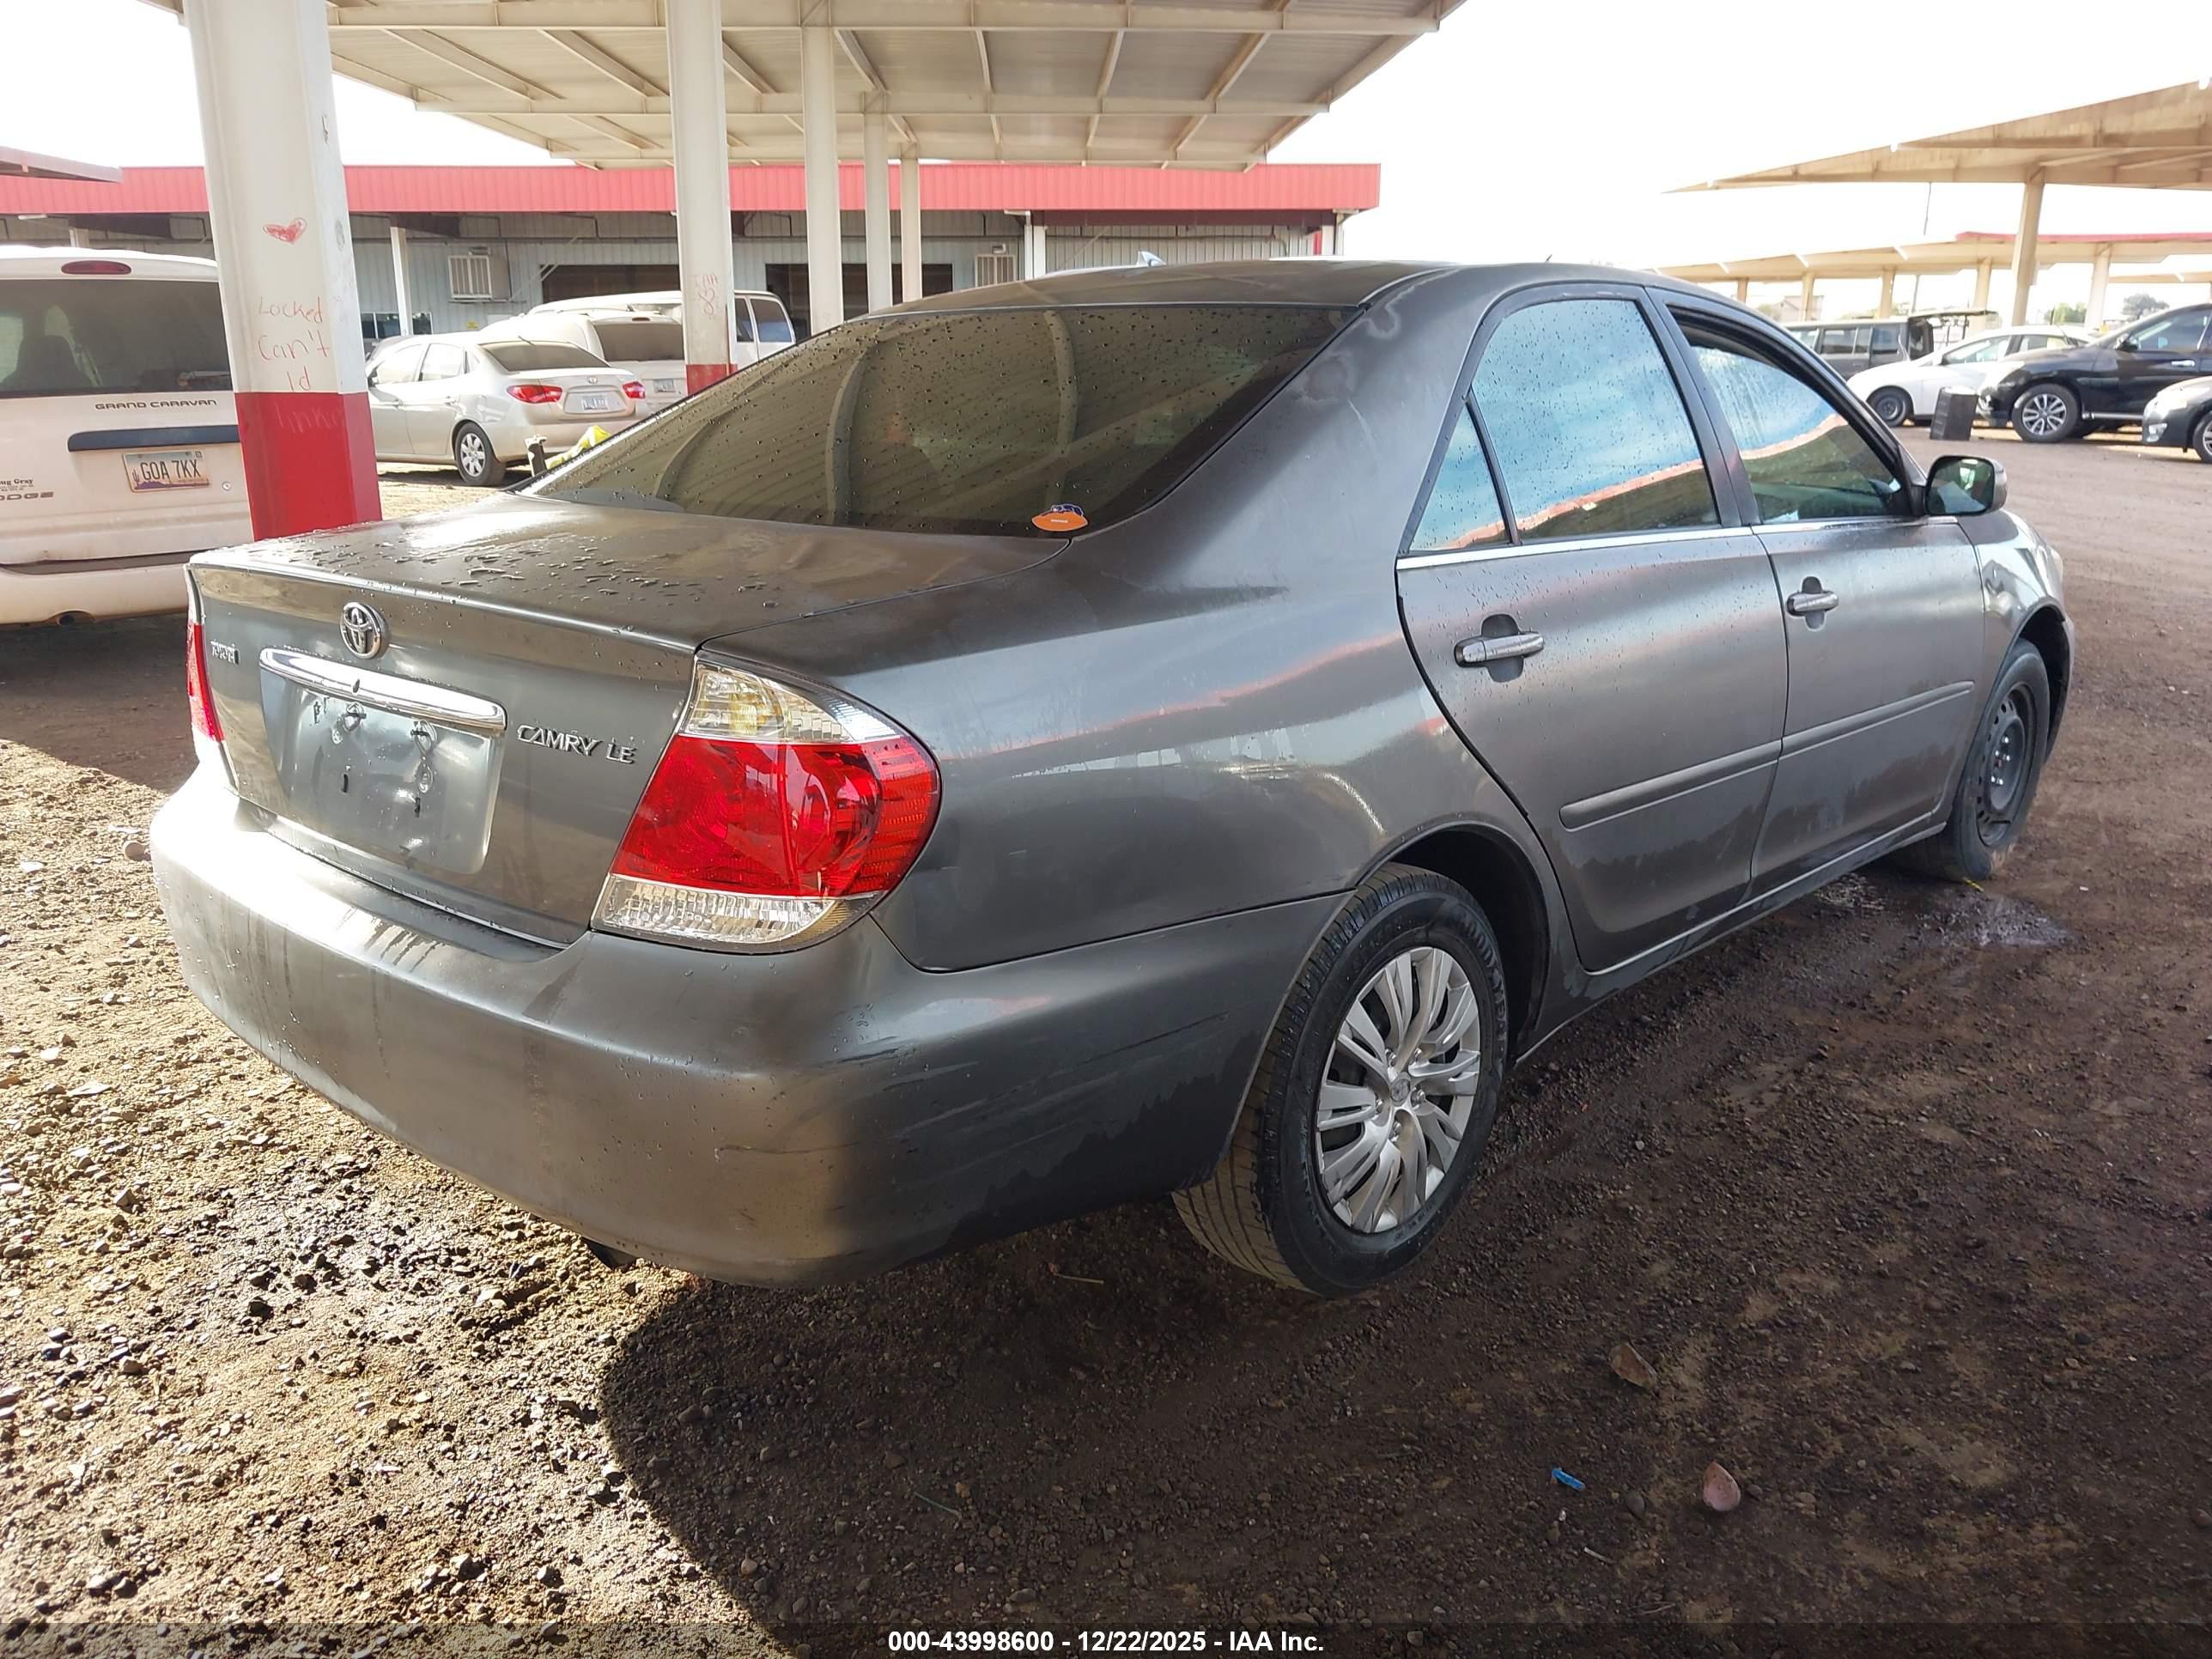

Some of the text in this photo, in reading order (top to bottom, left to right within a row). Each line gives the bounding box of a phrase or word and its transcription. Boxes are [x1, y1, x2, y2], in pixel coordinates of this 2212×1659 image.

[258, 295, 324, 324] Locked
[258, 330, 331, 361] Can't
[94, 399, 218, 410] GRAND CARAVAN
[172, 459, 202, 478] 7KX
[517, 724, 637, 764] CAMRY LE
